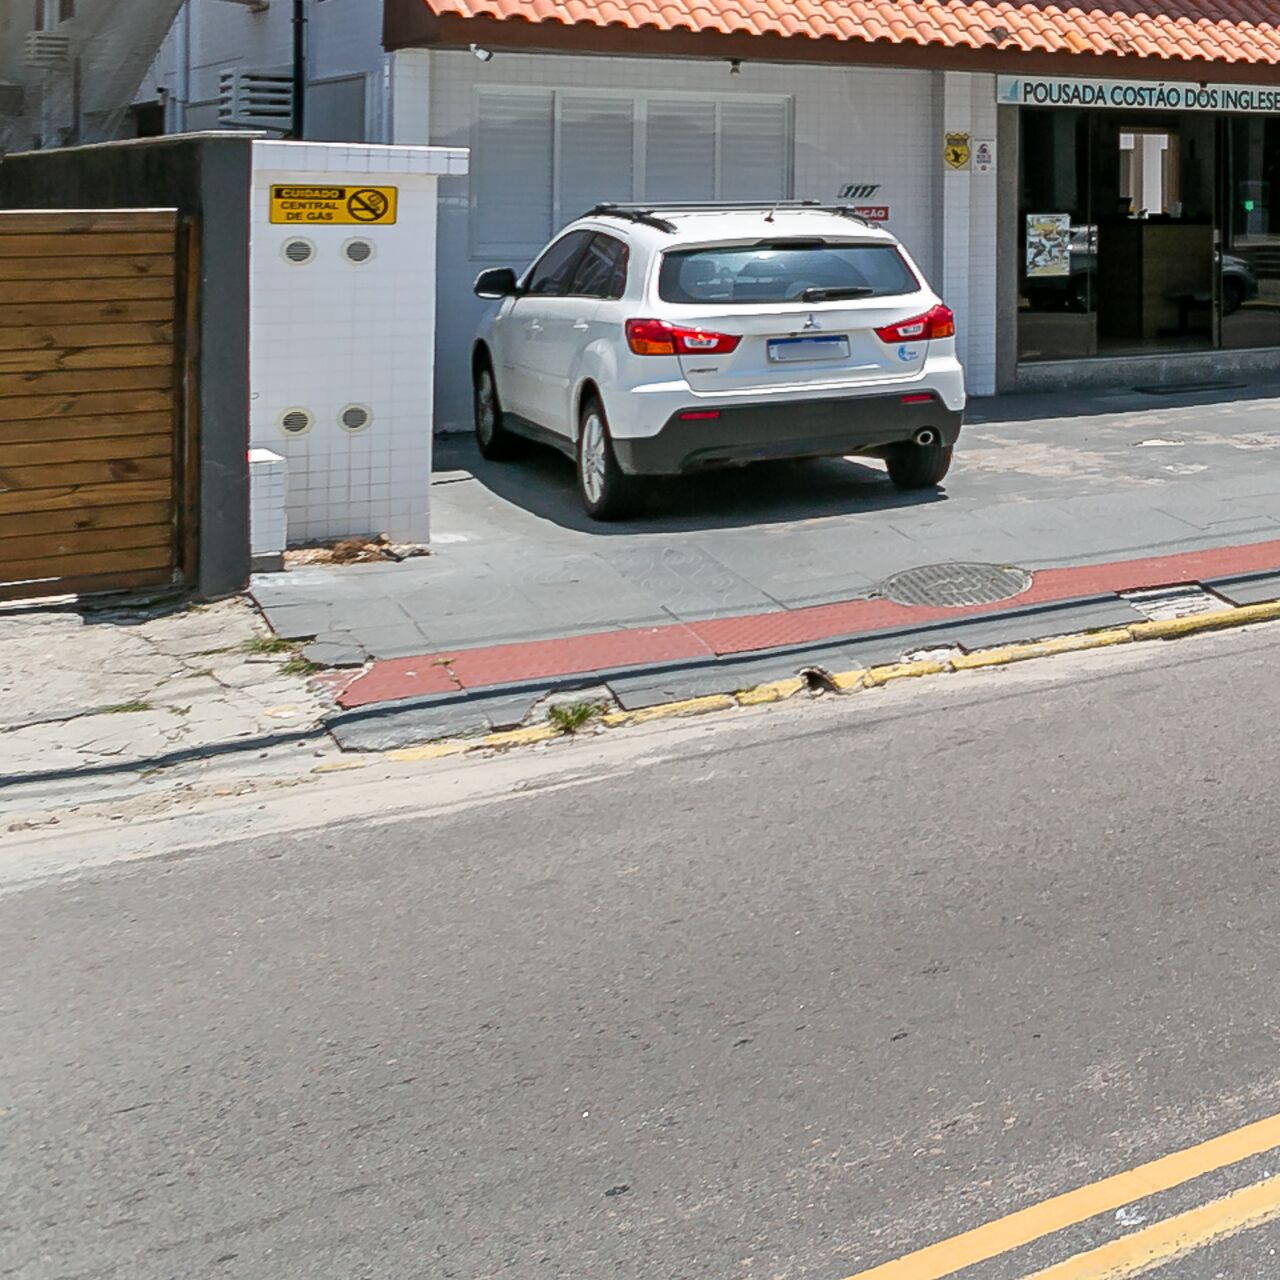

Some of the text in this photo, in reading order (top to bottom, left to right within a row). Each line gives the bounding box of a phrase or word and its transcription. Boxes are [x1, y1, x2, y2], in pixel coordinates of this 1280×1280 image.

[1024, 82, 1106, 106] POUSADA
[1110, 83, 1181, 108] COSTÃO
[1185, 88, 1218, 109] DOS
[281, 189, 340, 198] CUIDADO
[280, 201, 338, 210] CENTRAL
[286, 212, 302, 221] DE
